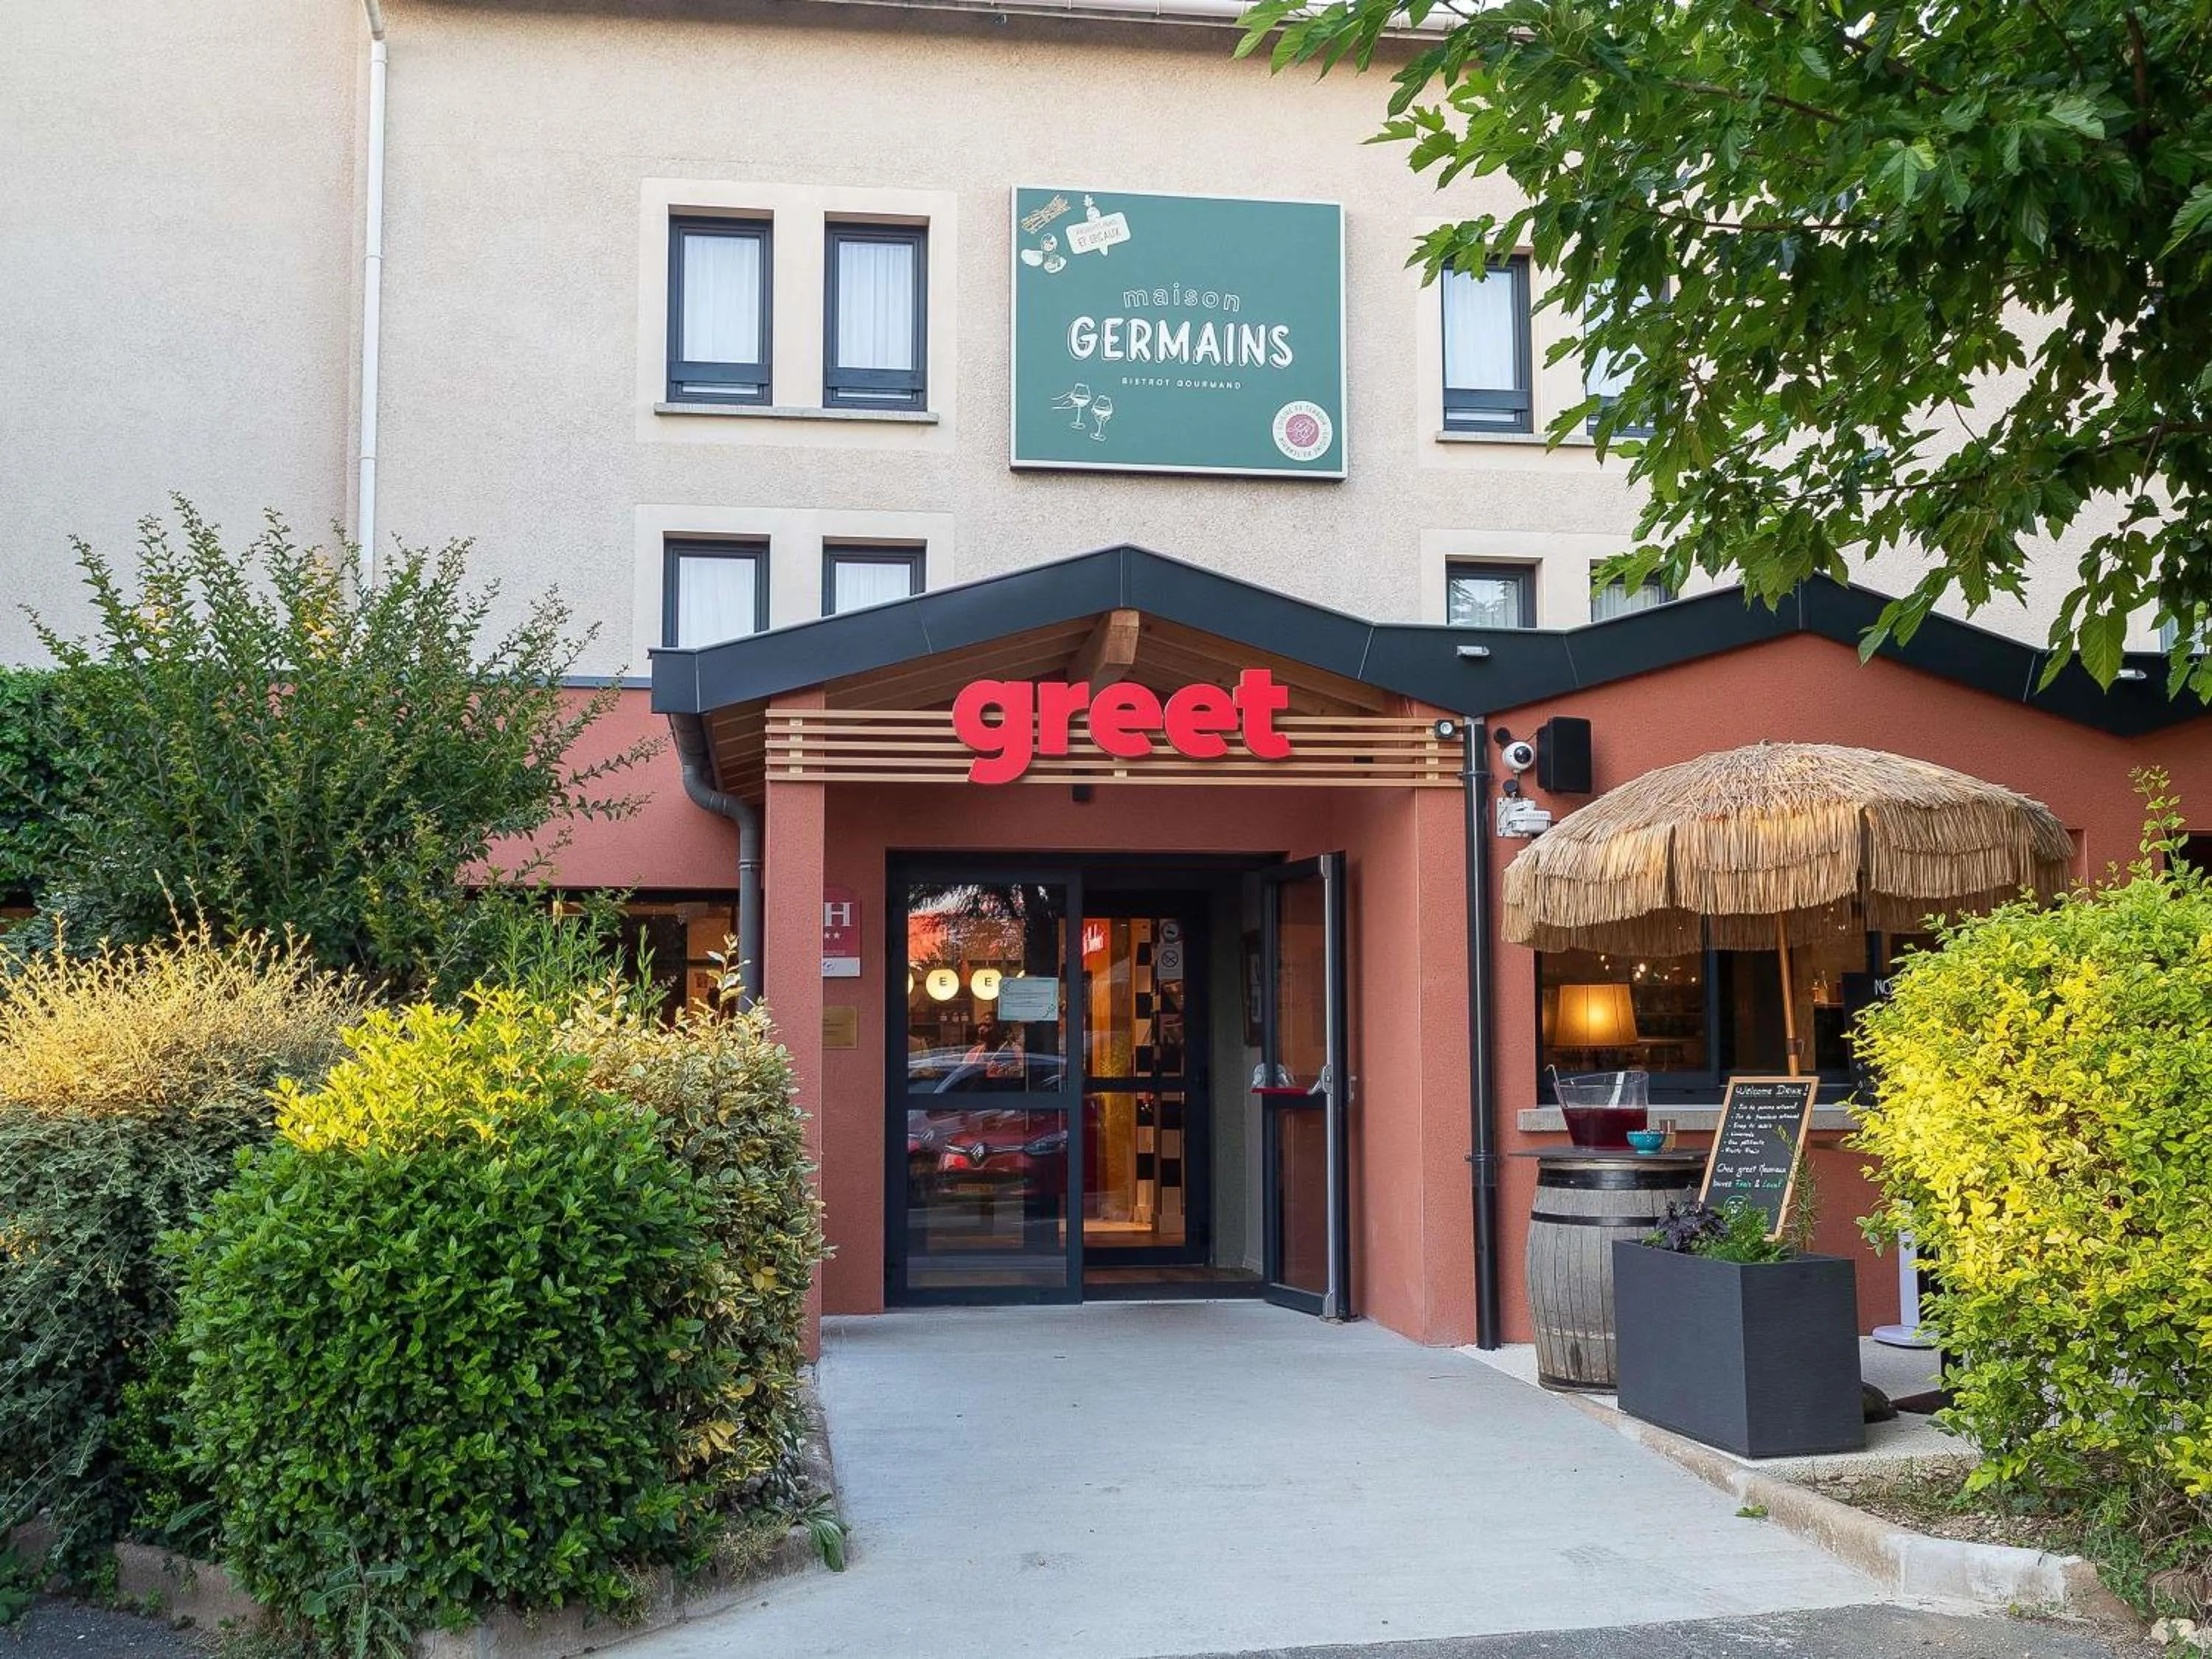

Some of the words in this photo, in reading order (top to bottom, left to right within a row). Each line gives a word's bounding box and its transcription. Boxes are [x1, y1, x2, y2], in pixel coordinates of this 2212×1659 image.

[1122, 282, 1241, 313] maison
[1067, 316, 1294, 369] GERMAINS
[1121, 377, 1169, 386] BISTROT
[1176, 380, 1242, 390] GOURMAND
[952, 669, 1291, 785] greet
[823, 902, 855, 927] H
[1735, 1085, 1772, 1096] Welcome
[1736, 1164, 1757, 1178] greet
[1754, 1179, 1761, 1188] &
